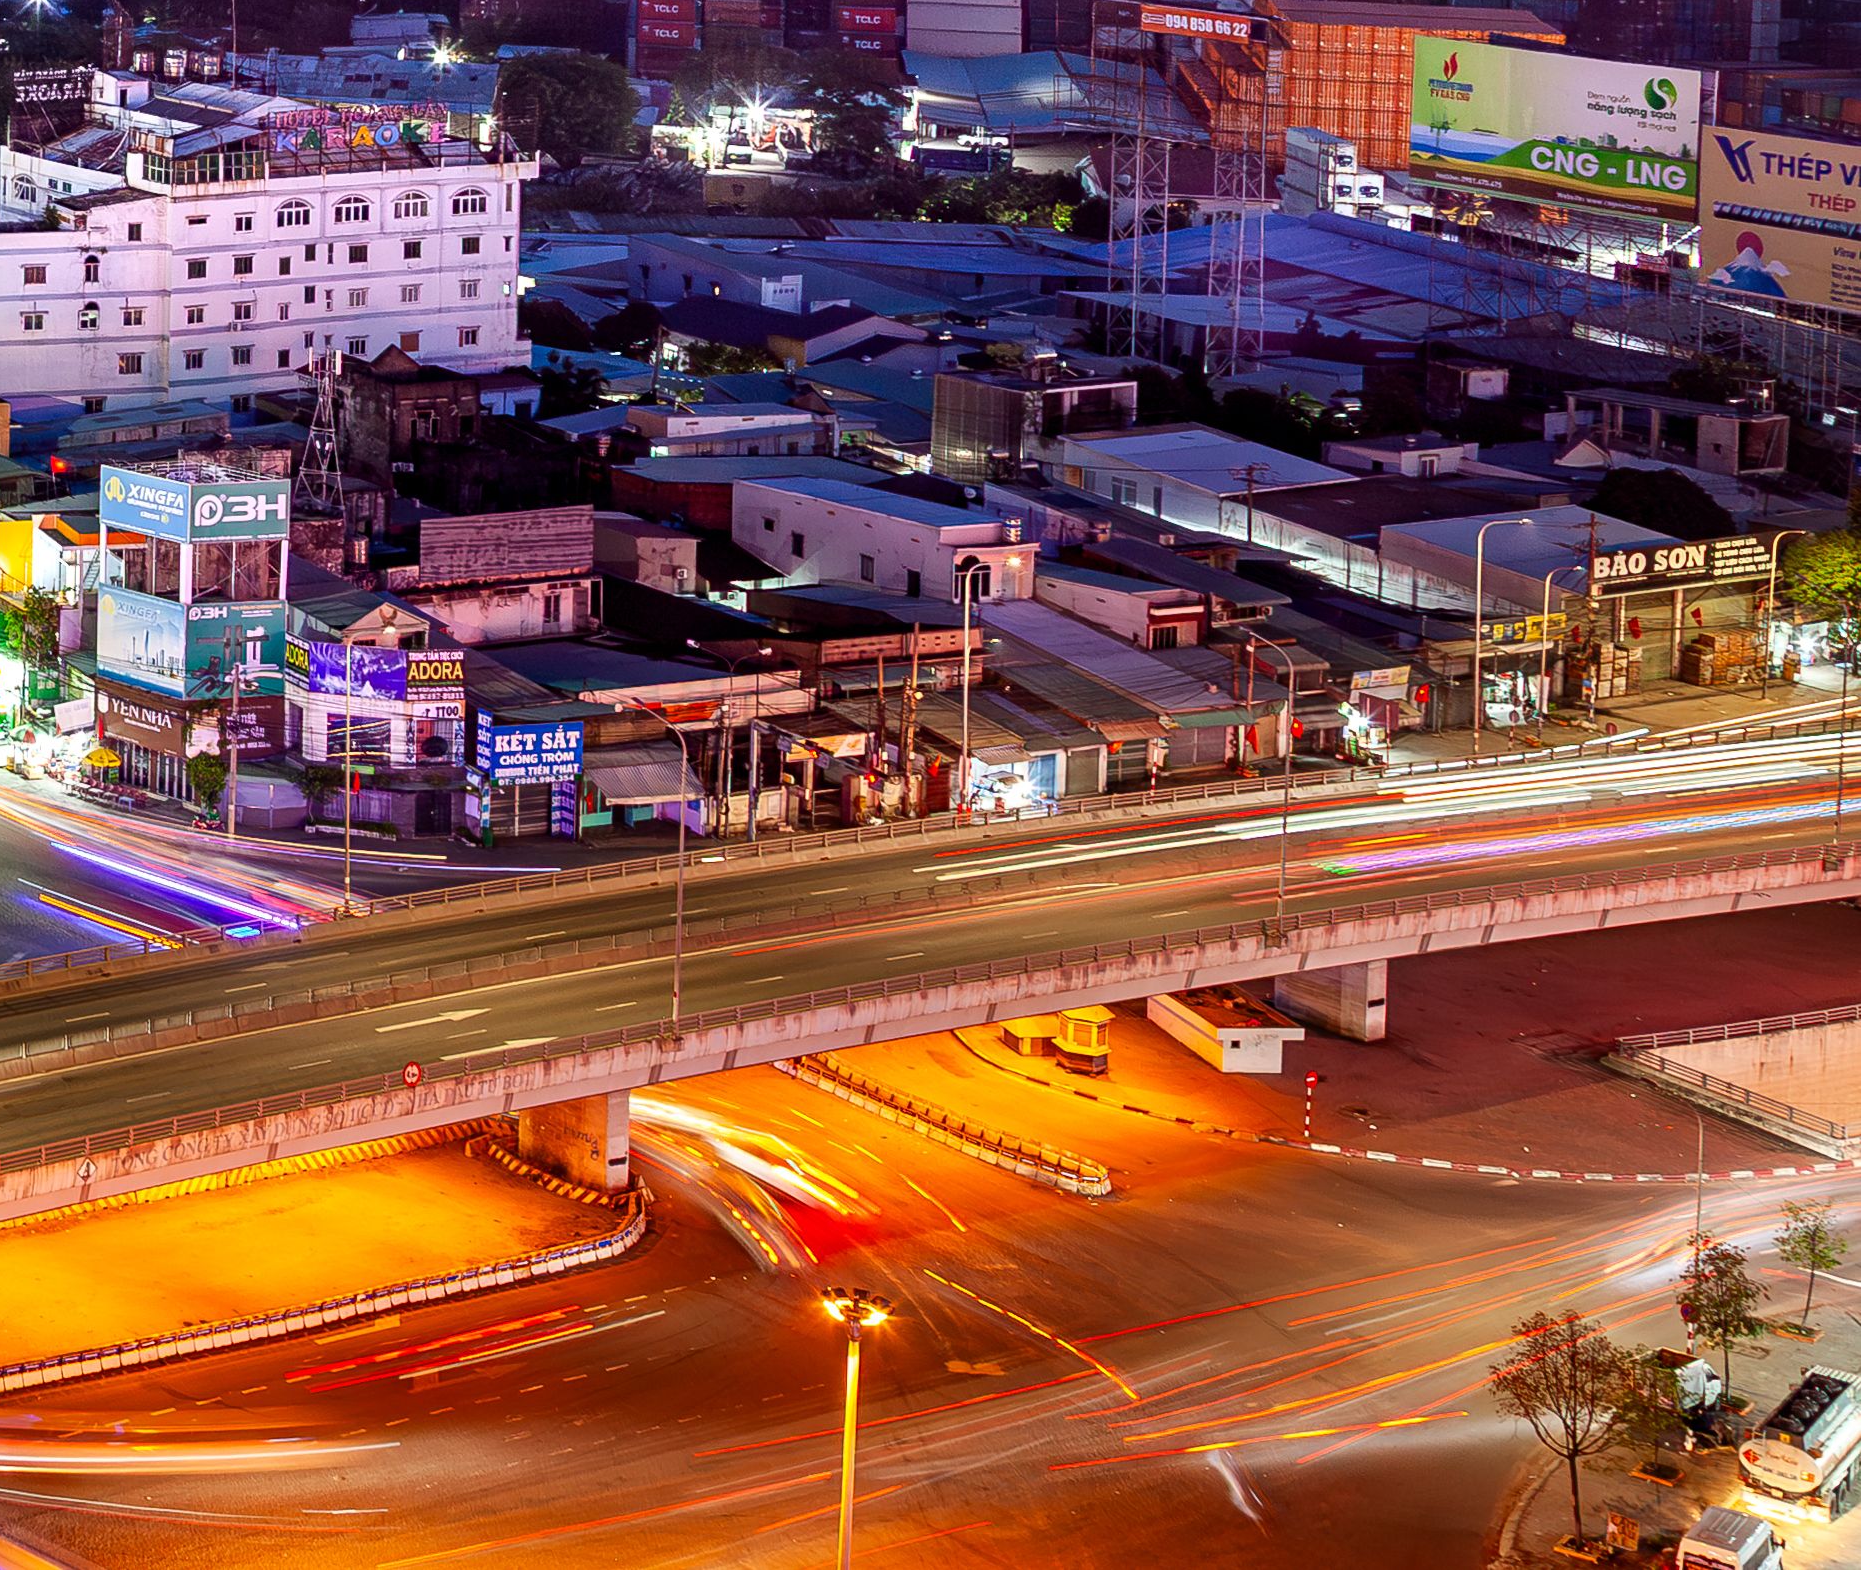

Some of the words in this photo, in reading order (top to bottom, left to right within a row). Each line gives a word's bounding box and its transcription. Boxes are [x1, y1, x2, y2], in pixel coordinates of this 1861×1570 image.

[1233, 23, 1248, 37] 22
[275, 121, 449, 152] KARAOKE
[1530, 145, 1599, 178] CNG
[1626, 159, 1687, 191] LNG
[1759, 151, 1833, 182] THÉP
[1807, 192, 1857, 213] THÉP
[129, 483, 185, 509] XINGFA
[1593, 550, 1647, 579] BẢO
[1653, 544, 1707, 572] SƠN
[118, 603, 159, 622] XINGFA
[408, 661, 464, 681] ADORA
[494, 730, 536, 752] KÉT
[541, 725, 580, 750] SẮT
